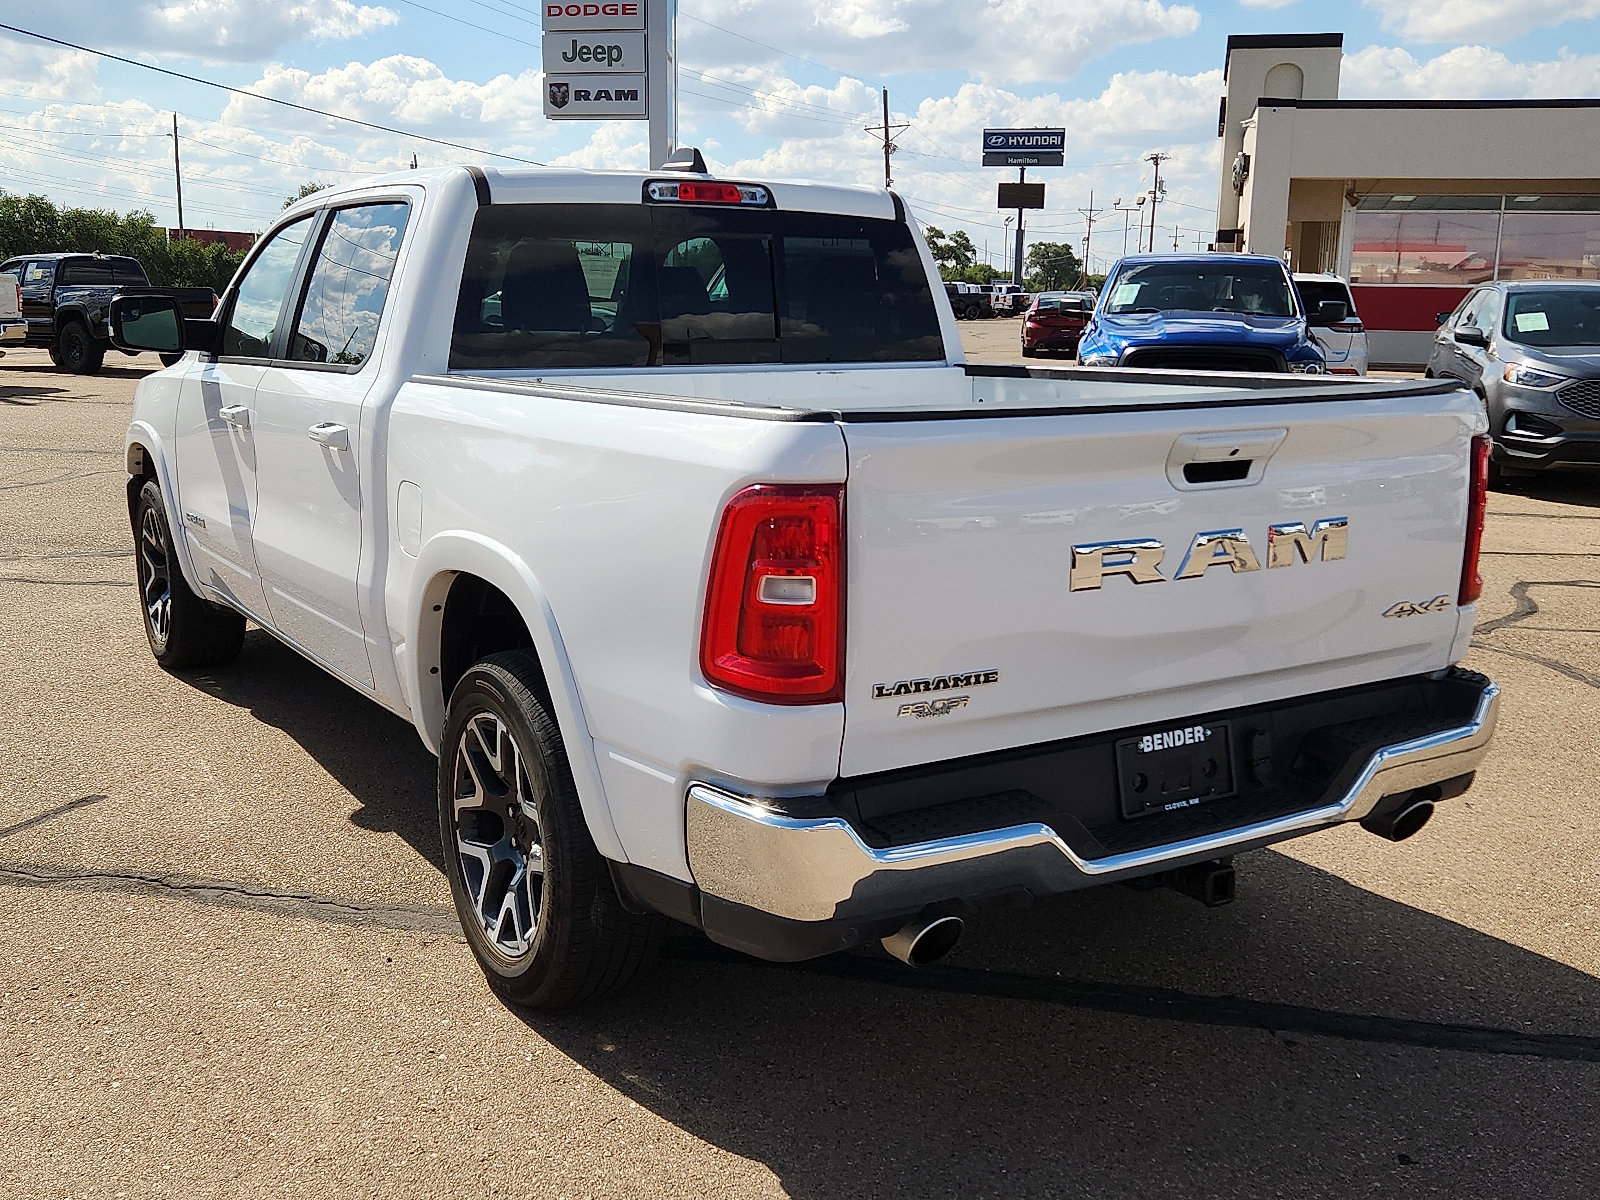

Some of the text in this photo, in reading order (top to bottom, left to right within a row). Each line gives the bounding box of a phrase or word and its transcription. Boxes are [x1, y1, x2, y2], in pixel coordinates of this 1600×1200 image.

[547, 3, 638, 17] DODGE
[562, 39, 623, 67] Jeep
[574, 89, 639, 102] RAM
[1008, 135, 1062, 146] HYUNDAI
[1070, 516, 1348, 592] RAM
[872, 668, 999, 699] LARAMIE
[1142, 725, 1206, 753] BENDER
